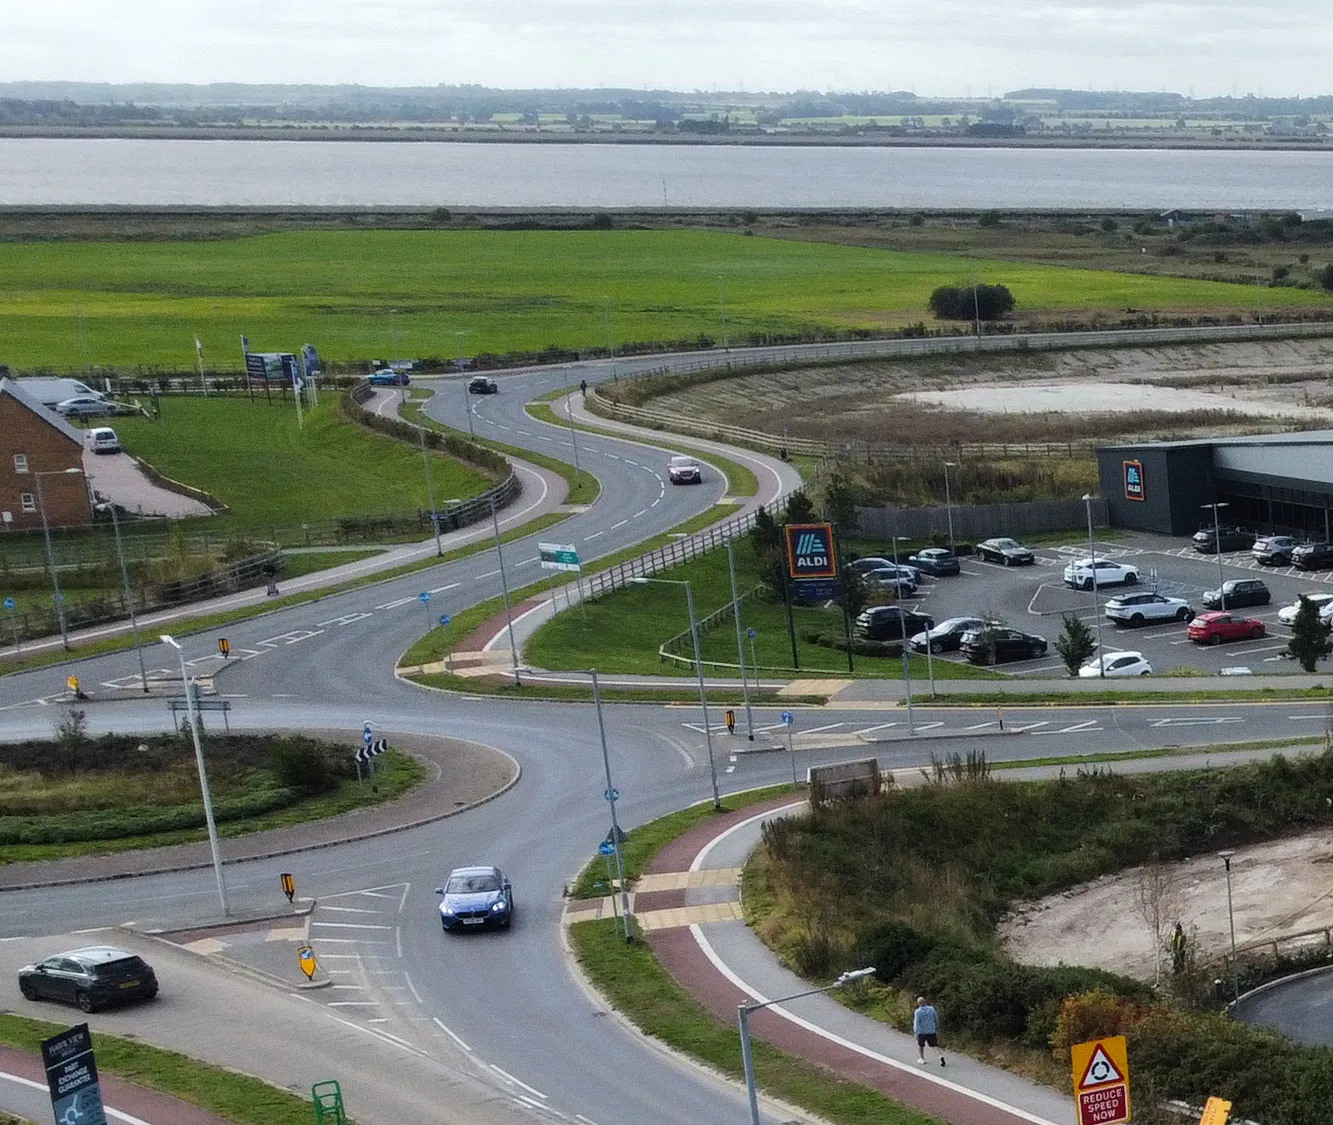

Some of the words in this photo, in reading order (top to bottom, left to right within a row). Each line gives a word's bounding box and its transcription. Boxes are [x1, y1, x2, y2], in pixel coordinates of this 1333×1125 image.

[797, 556, 828, 567] ALDI
[1083, 1088, 1122, 1105] REDUCE
[1088, 1099, 1119, 1113] SPEED
[1093, 1109, 1116, 1121] NOW
